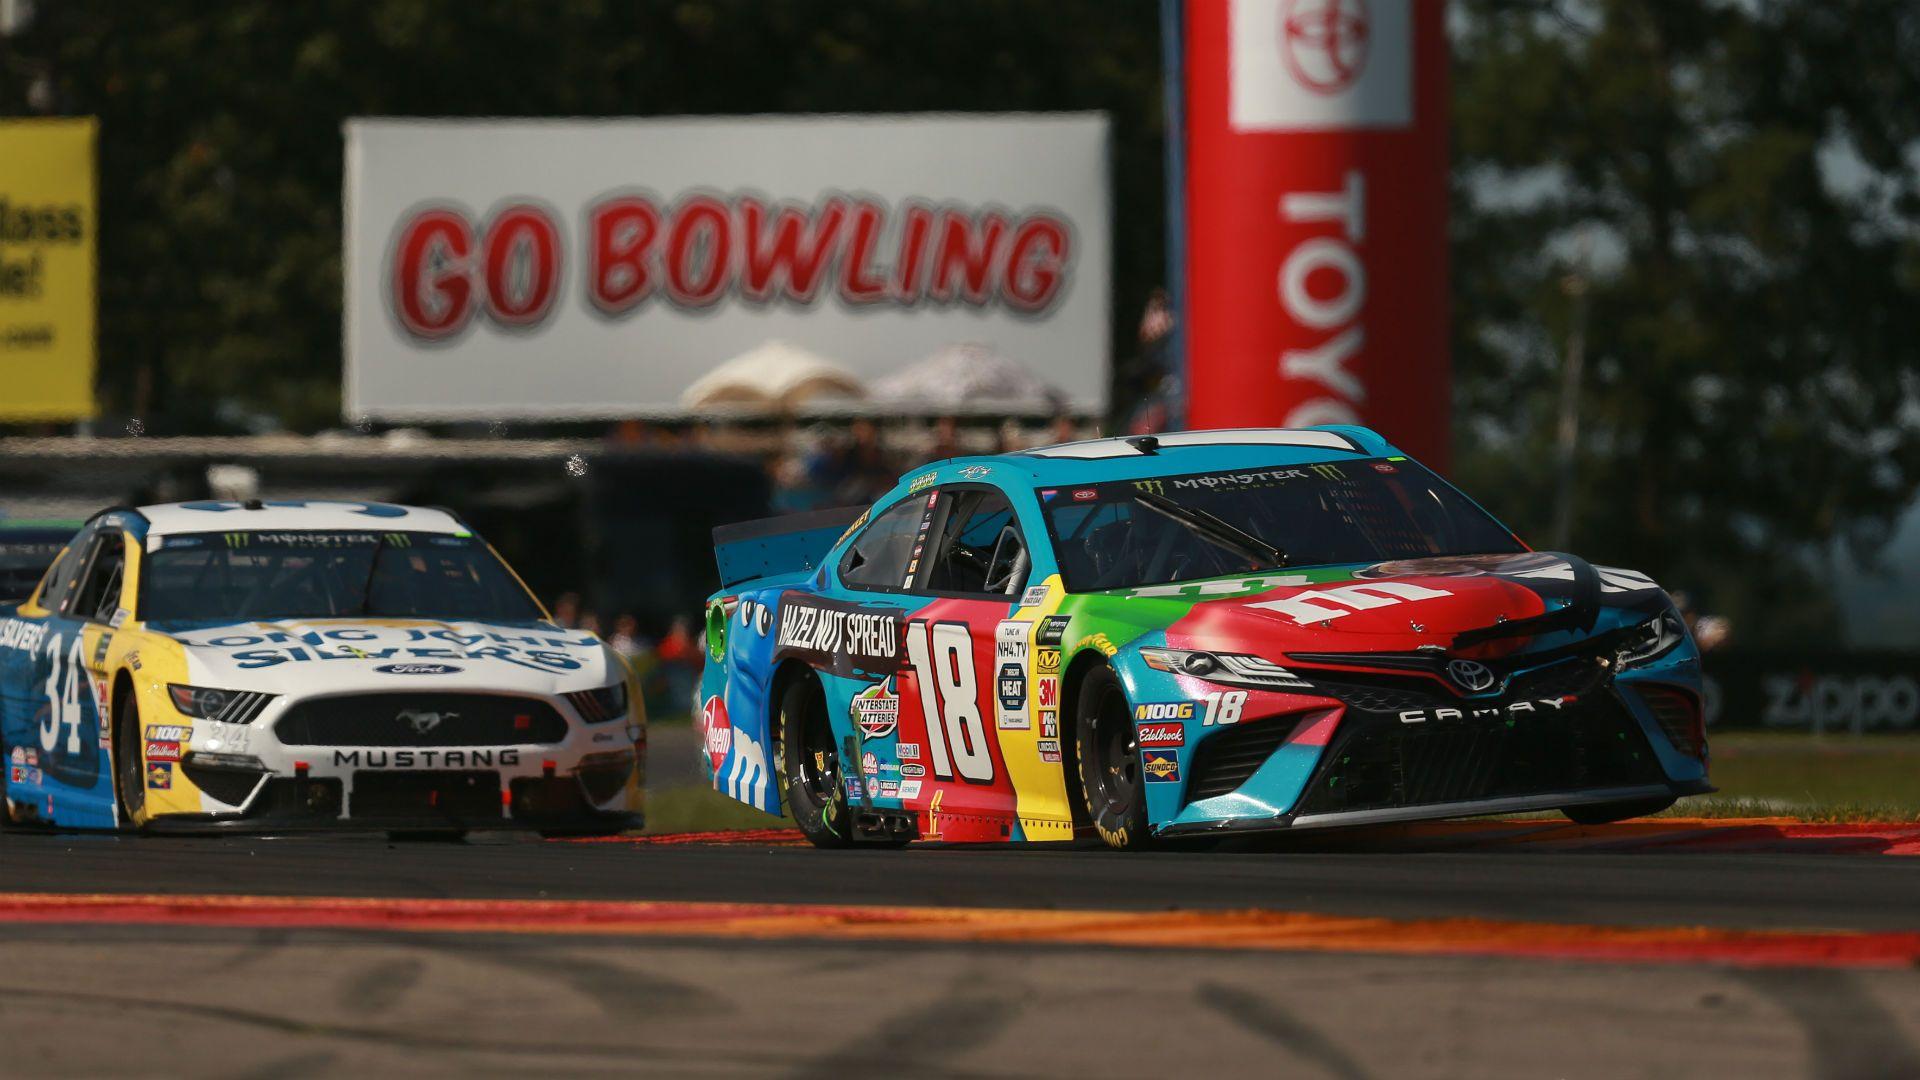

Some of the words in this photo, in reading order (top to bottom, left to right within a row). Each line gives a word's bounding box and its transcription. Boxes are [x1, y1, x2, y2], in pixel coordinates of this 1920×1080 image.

[392, 204, 562, 341] GO
[587, 192, 1076, 318] BOWLING
[1174, 469, 1309, 489] MONSTER
[258, 533, 378, 545] MONSTER
[1243, 581, 1455, 625] m
[406, 628, 601, 648] JOHN
[777, 604, 847, 653] HAZELNUT
[846, 612, 897, 658] SPREAD
[998, 641, 1027, 657] NH4.TV
[392, 664, 445, 674] Ford
[40, 633, 81, 753] 34
[1002, 680, 1022, 697] HEAT
[1039, 679, 1057, 706] 3M
[855, 699, 897, 711] INTERSTATE
[905, 619, 994, 783] 18
[1203, 691, 1248, 726] 18
[859, 712, 895, 723] ATTERIES
[1136, 703, 1194, 720] MOOG
[1140, 727, 1183, 742] Edelbrock
[333, 749, 520, 767] MUSTANG
[1145, 763, 1178, 772] SUNOCO
[728, 725, 768, 812] m
